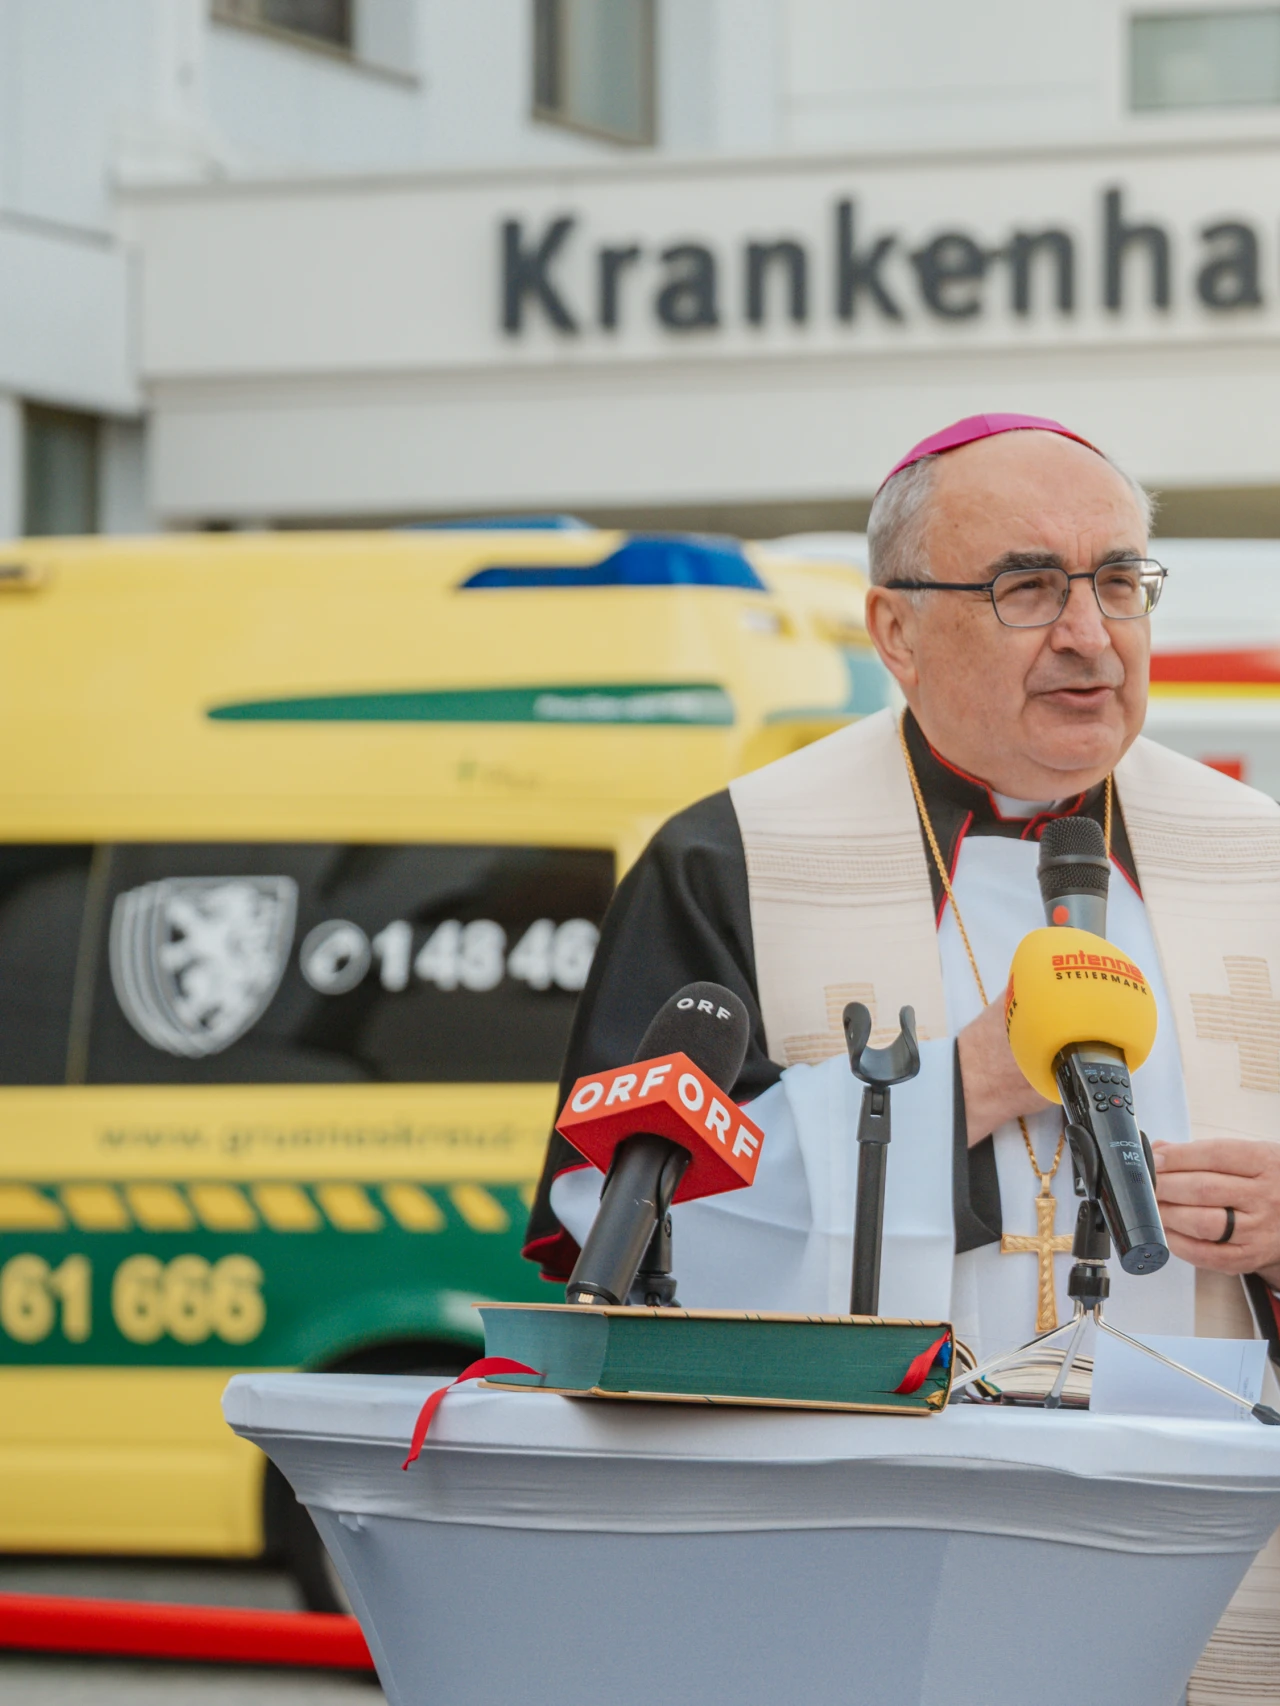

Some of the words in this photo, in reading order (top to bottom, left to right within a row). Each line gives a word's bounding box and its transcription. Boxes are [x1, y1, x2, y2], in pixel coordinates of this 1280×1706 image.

[1052, 949, 1144, 981] antenne
[1056, 971, 1148, 995] STEIERMARK
[677, 998, 731, 1020] ORF
[571, 1064, 672, 1113] ORF
[678, 1073, 759, 1158] ORF
[1122, 1151, 1141, 1162] M2
[111, 1253, 267, 1345] 666
